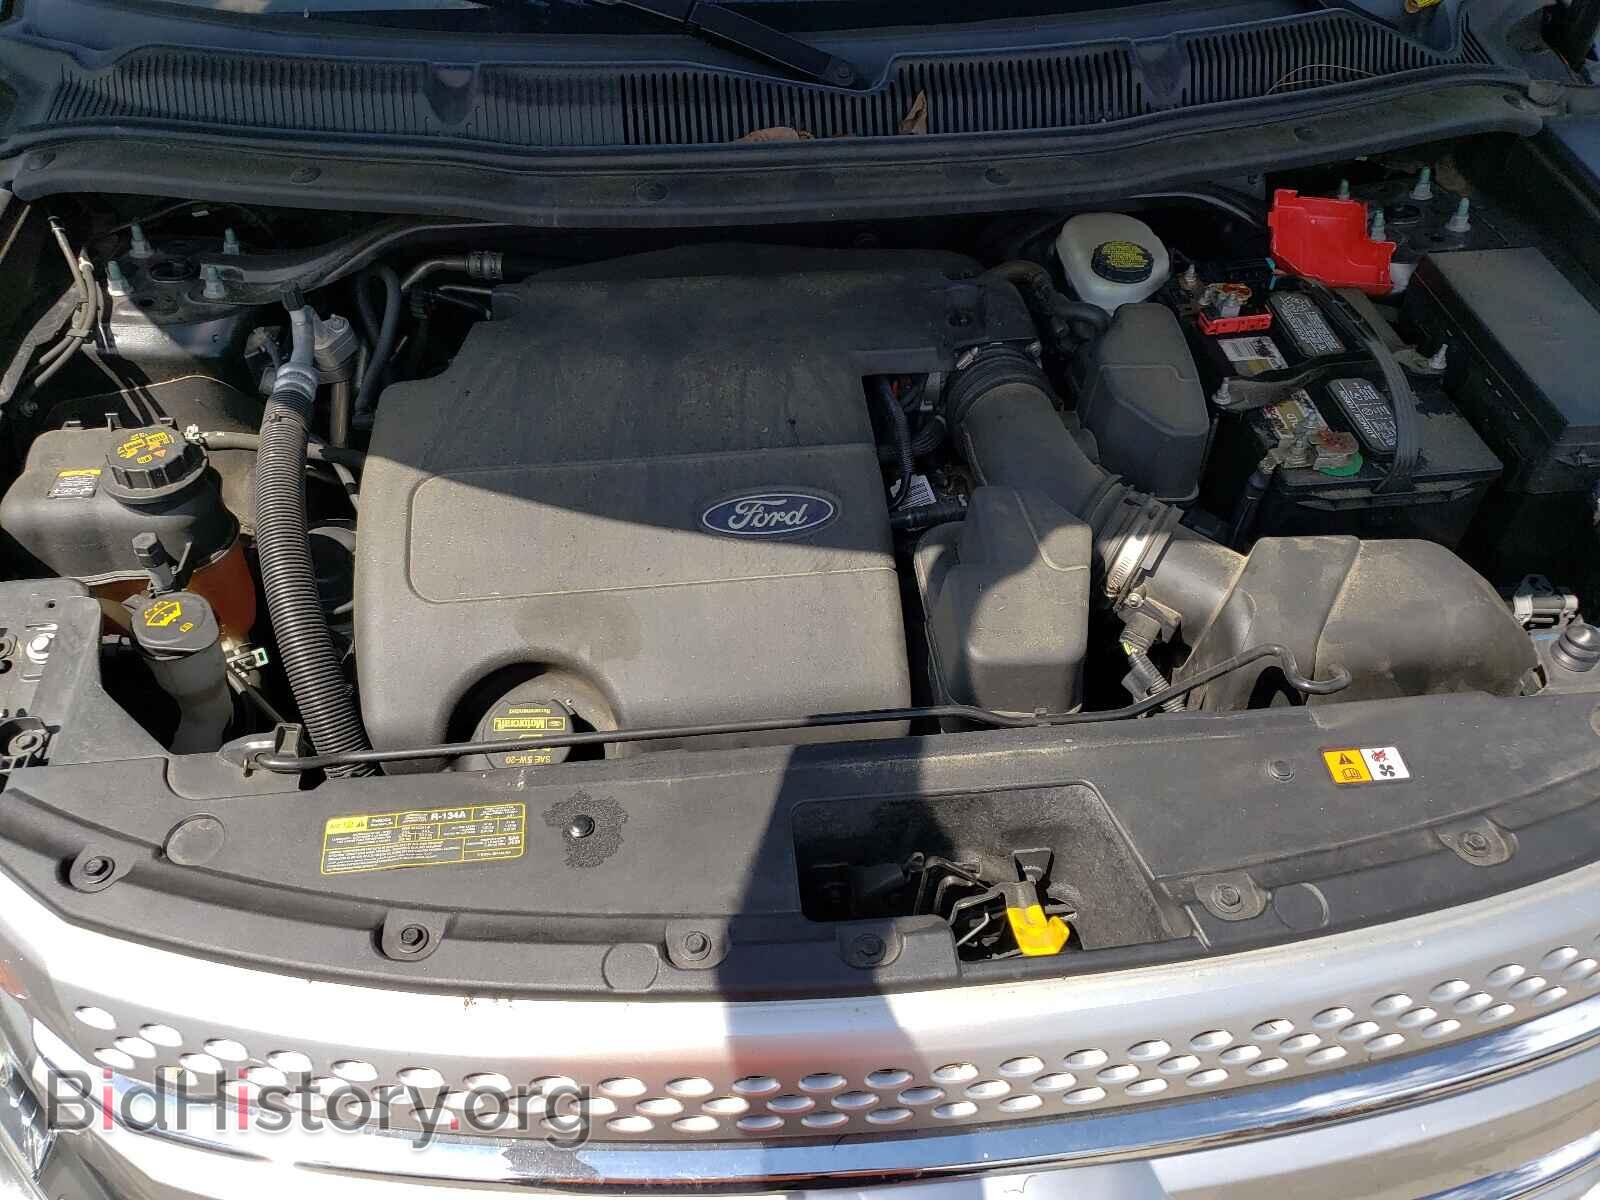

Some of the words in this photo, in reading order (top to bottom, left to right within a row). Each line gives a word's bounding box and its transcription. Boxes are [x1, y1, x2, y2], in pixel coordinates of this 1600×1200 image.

[727, 499, 808, 530] Ford
[496, 718, 545, 729] Motorcraft
[505, 755, 533, 764] 5W-20
[534, 755, 551, 764] SAE
[430, 811, 466, 821] R-134A
